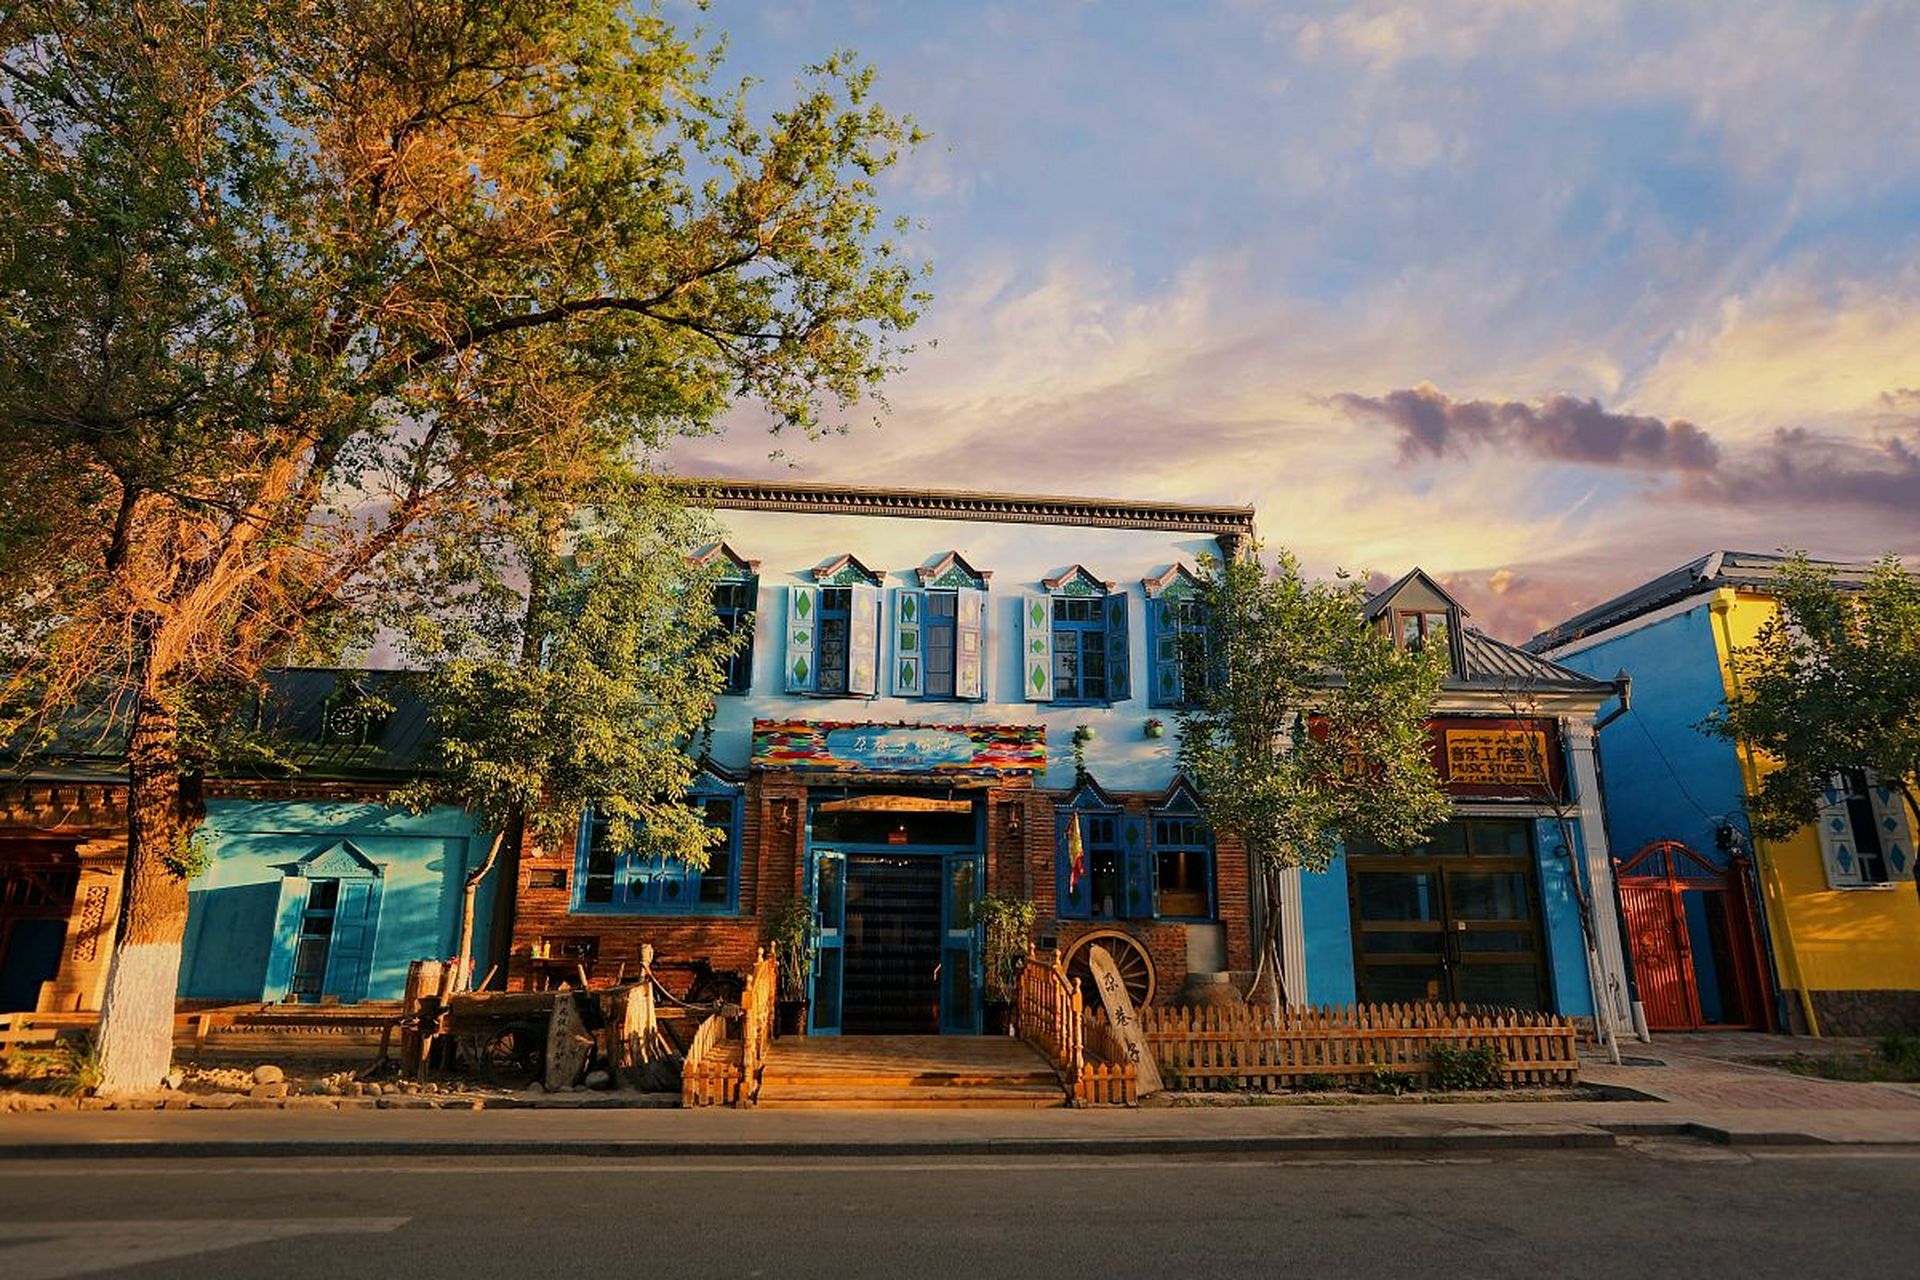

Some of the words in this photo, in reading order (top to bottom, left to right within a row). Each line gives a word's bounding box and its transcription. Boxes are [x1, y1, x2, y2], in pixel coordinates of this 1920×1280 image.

[1451, 746, 1527, 762] 音乐工作室
[1451, 763, 1485, 774] MUSIC
[1488, 763, 1527, 775] STUDIO
